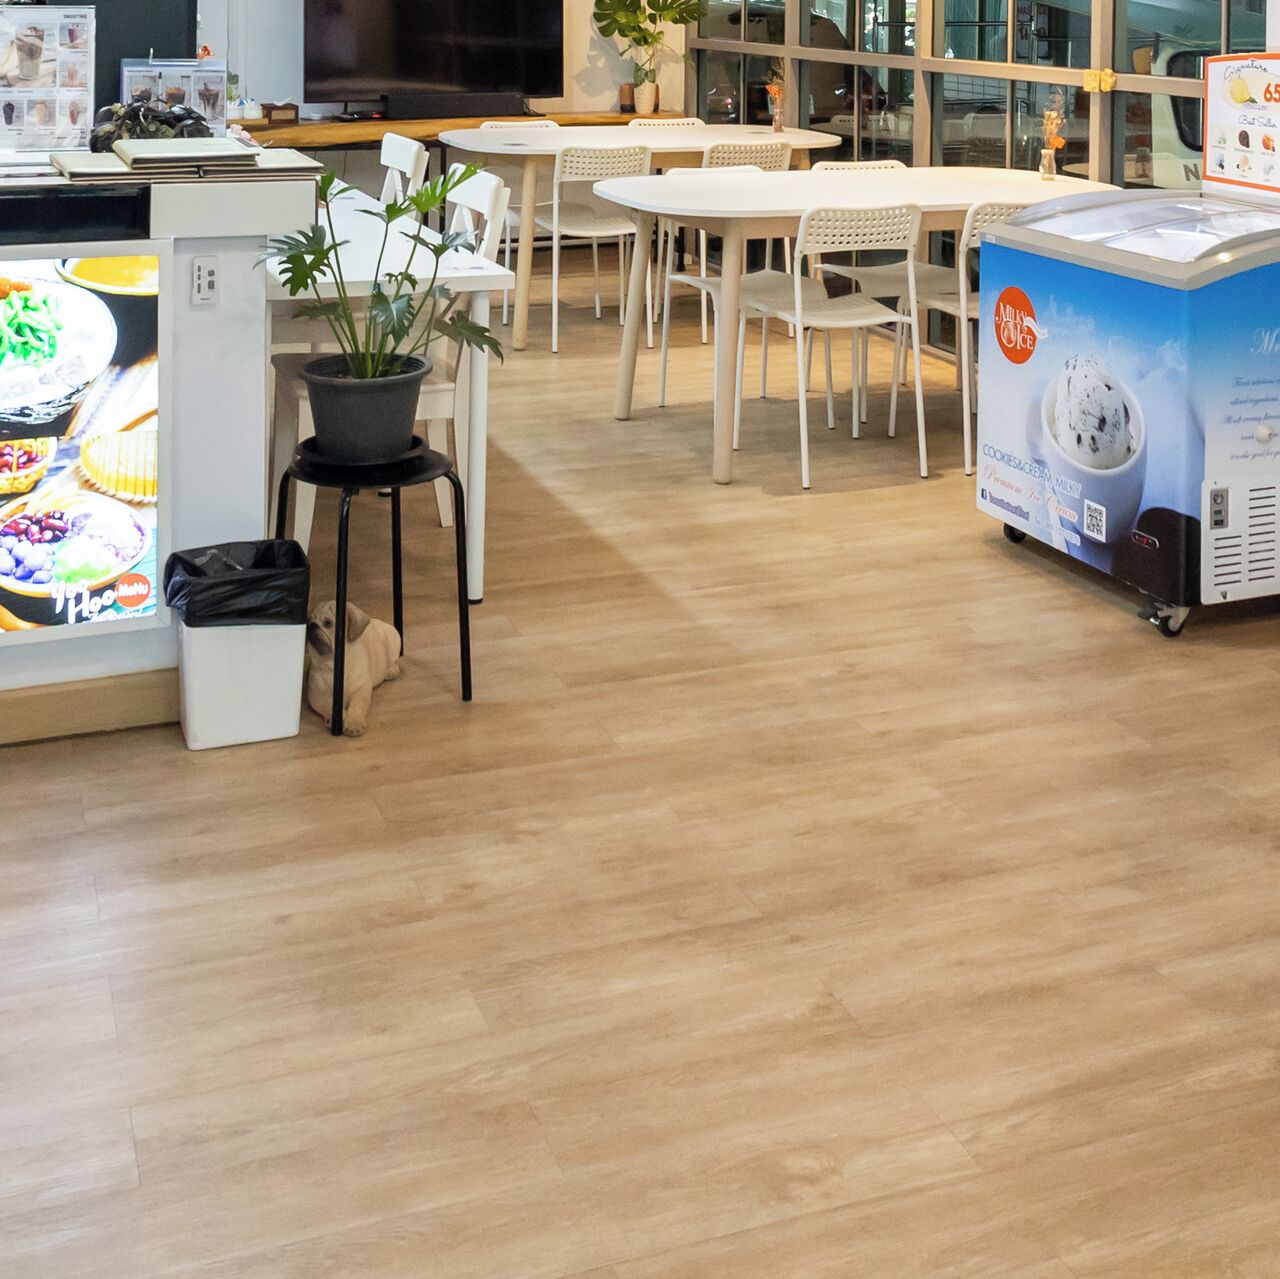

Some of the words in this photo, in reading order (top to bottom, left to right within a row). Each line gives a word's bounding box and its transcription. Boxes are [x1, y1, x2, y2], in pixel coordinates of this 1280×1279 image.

[1223, 58, 1269, 81] Signature
[1238, 113, 1257, 126] Best
[995, 302, 1028, 326] MILKY
[982, 442, 1052, 484] COOKIES&CREAM
[67, 588, 117, 625] Hoo
